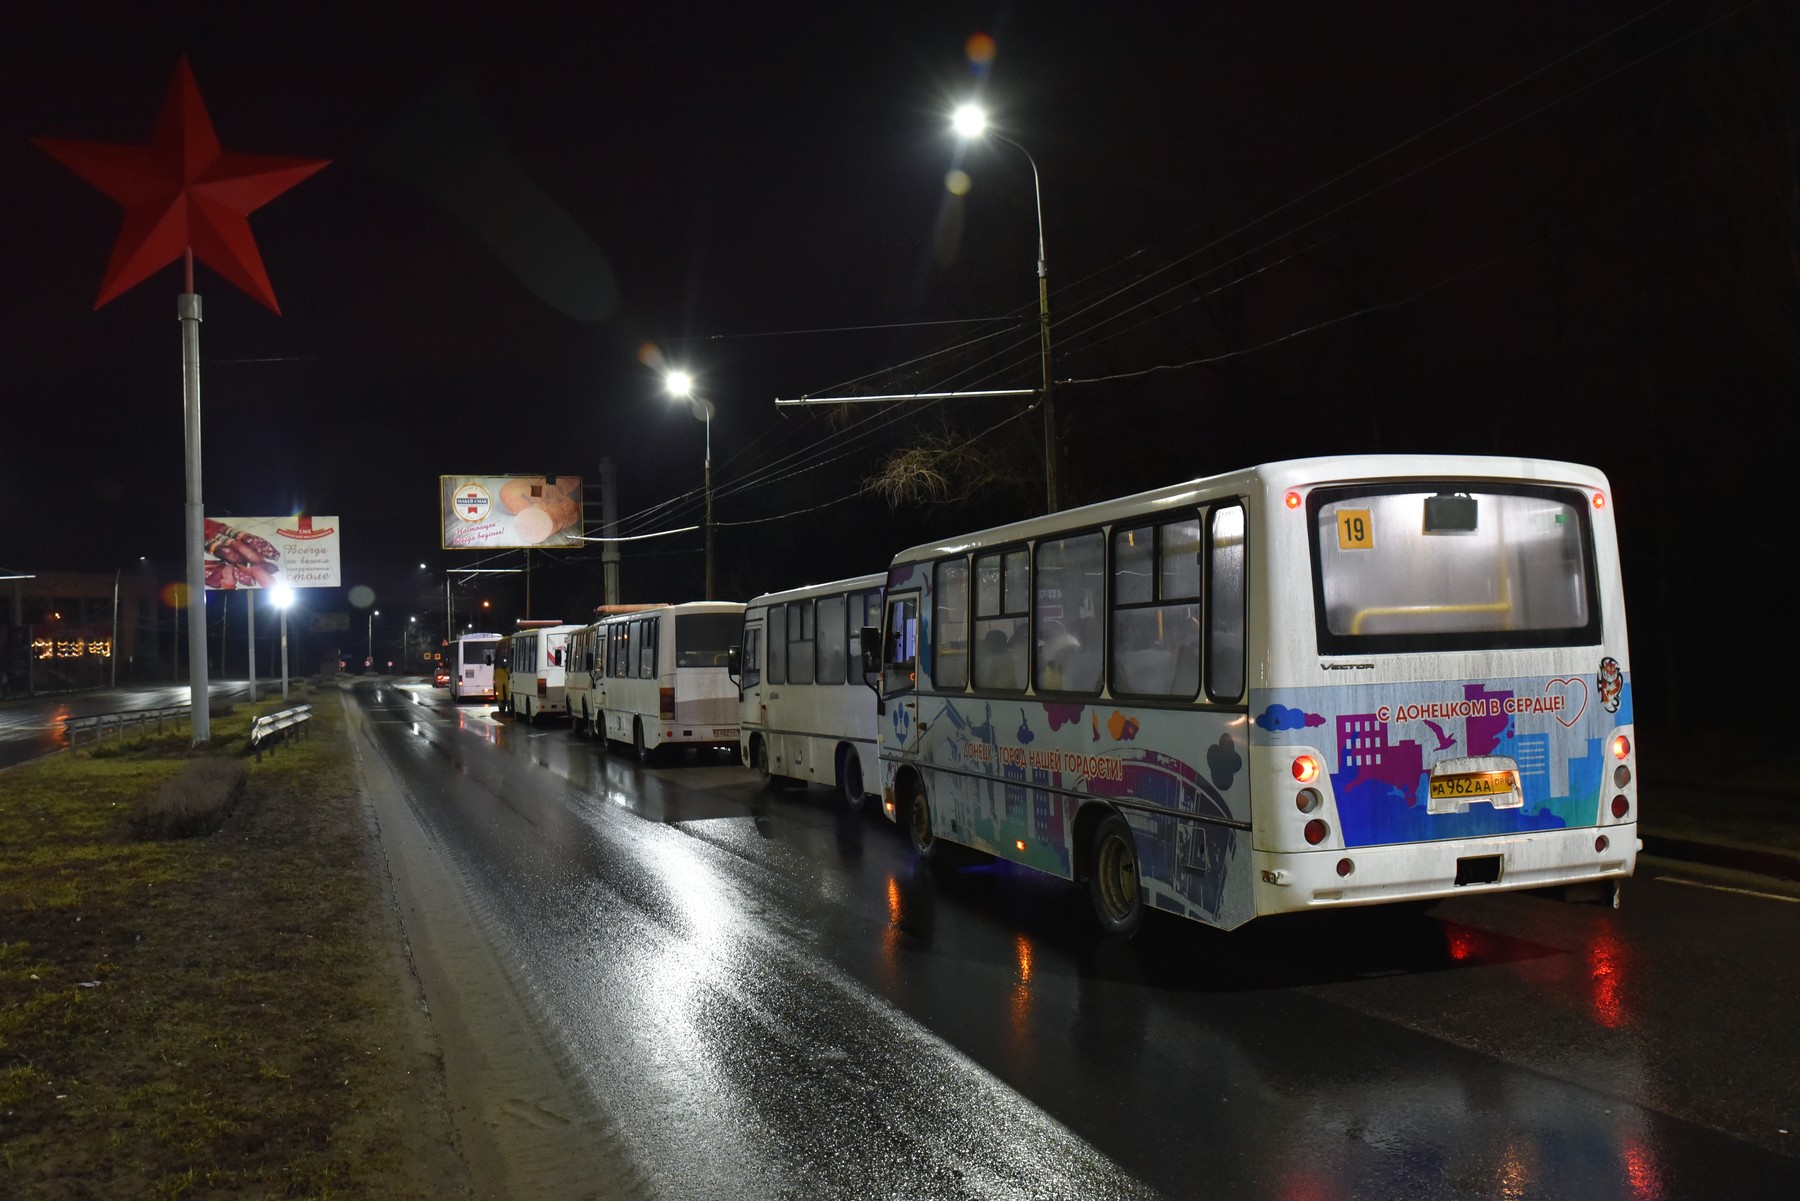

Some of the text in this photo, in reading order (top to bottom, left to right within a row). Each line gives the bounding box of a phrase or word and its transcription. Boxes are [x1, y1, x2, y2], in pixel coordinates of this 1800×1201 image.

[1344, 518, 1365, 542] 19
[283, 544, 328, 557] Всегда
[1377, 696, 1565, 722] С ДОНЕЦКОМ В СЕРДЦЕ!
[964, 743, 993, 762] ДОНЕЦК
[999, 746, 1026, 768] ГОРОД
[1030, 747, 1062, 772] НАШЕЙ
[1064, 754, 1123, 781] ГОРДОСТИ!
